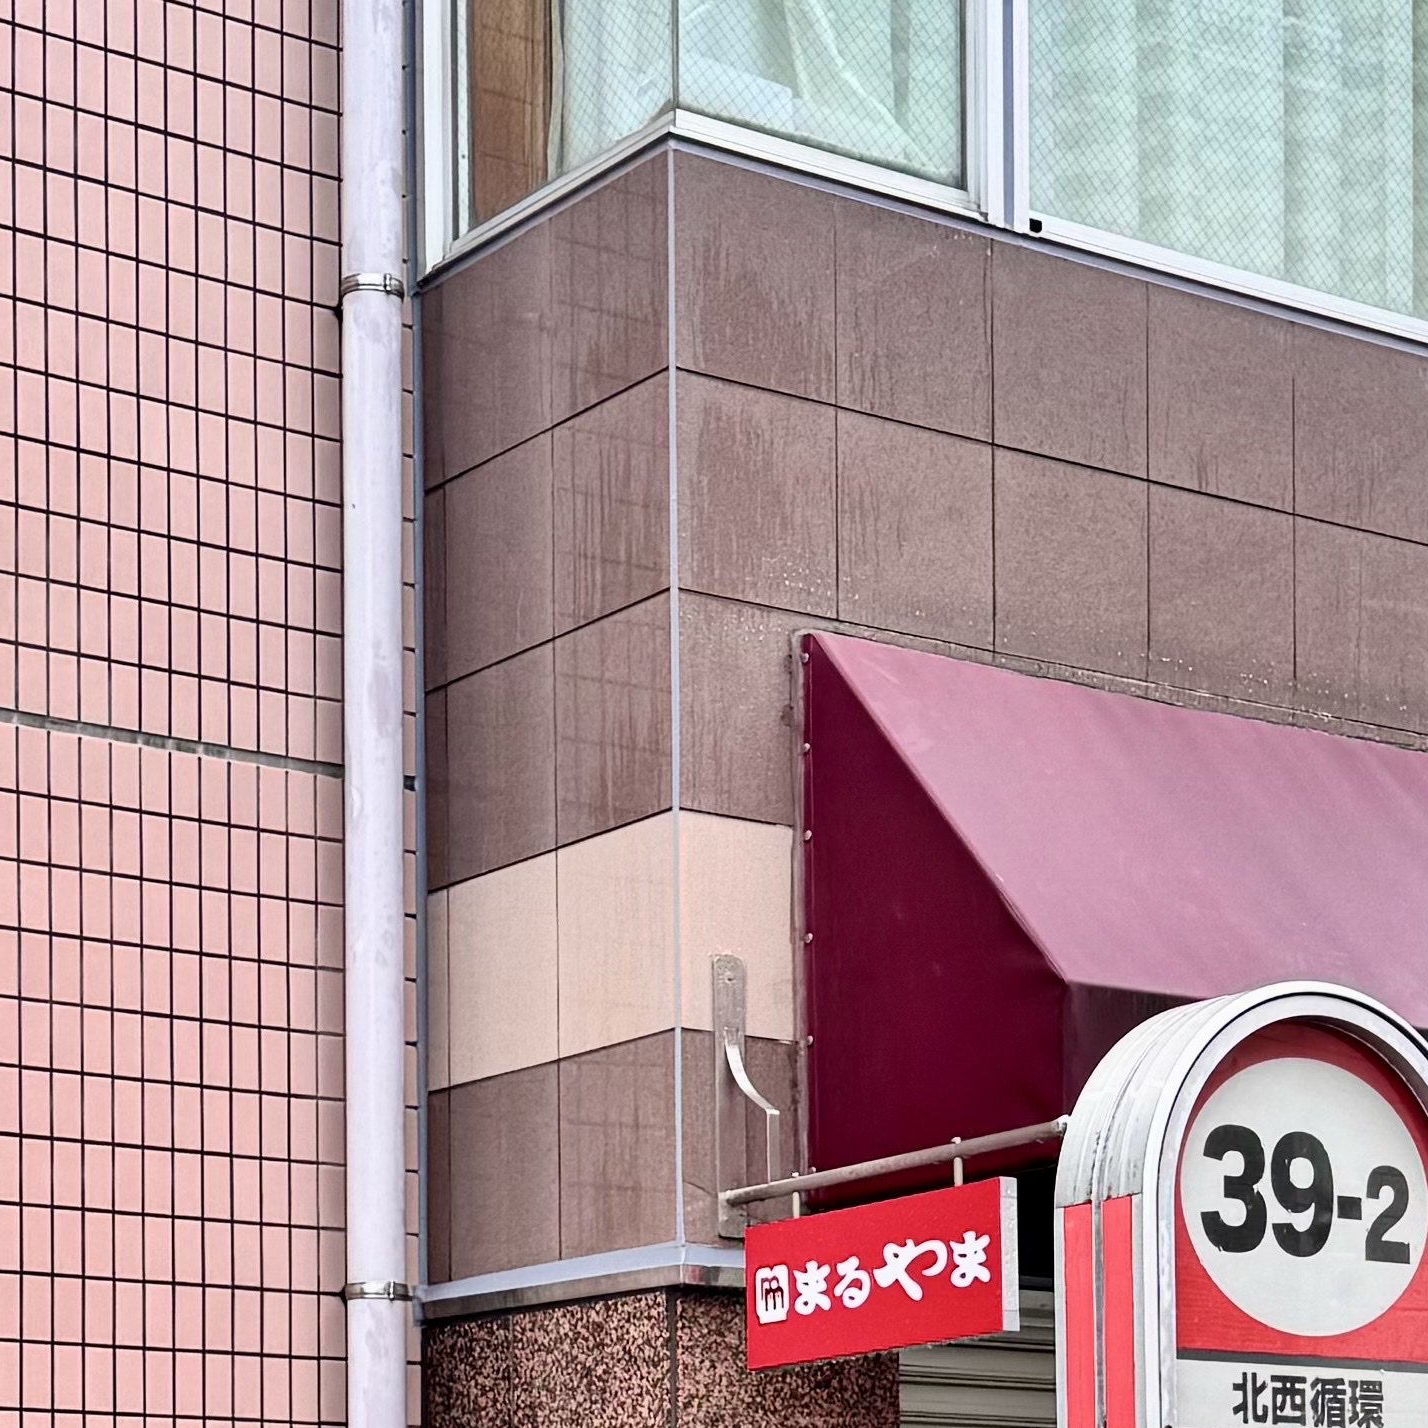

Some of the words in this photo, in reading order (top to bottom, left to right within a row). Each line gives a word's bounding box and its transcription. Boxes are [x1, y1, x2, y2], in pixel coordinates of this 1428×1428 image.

[1199, 1123, 1412, 1265] 39-2
[792, 1230, 992, 1316] まるやま
